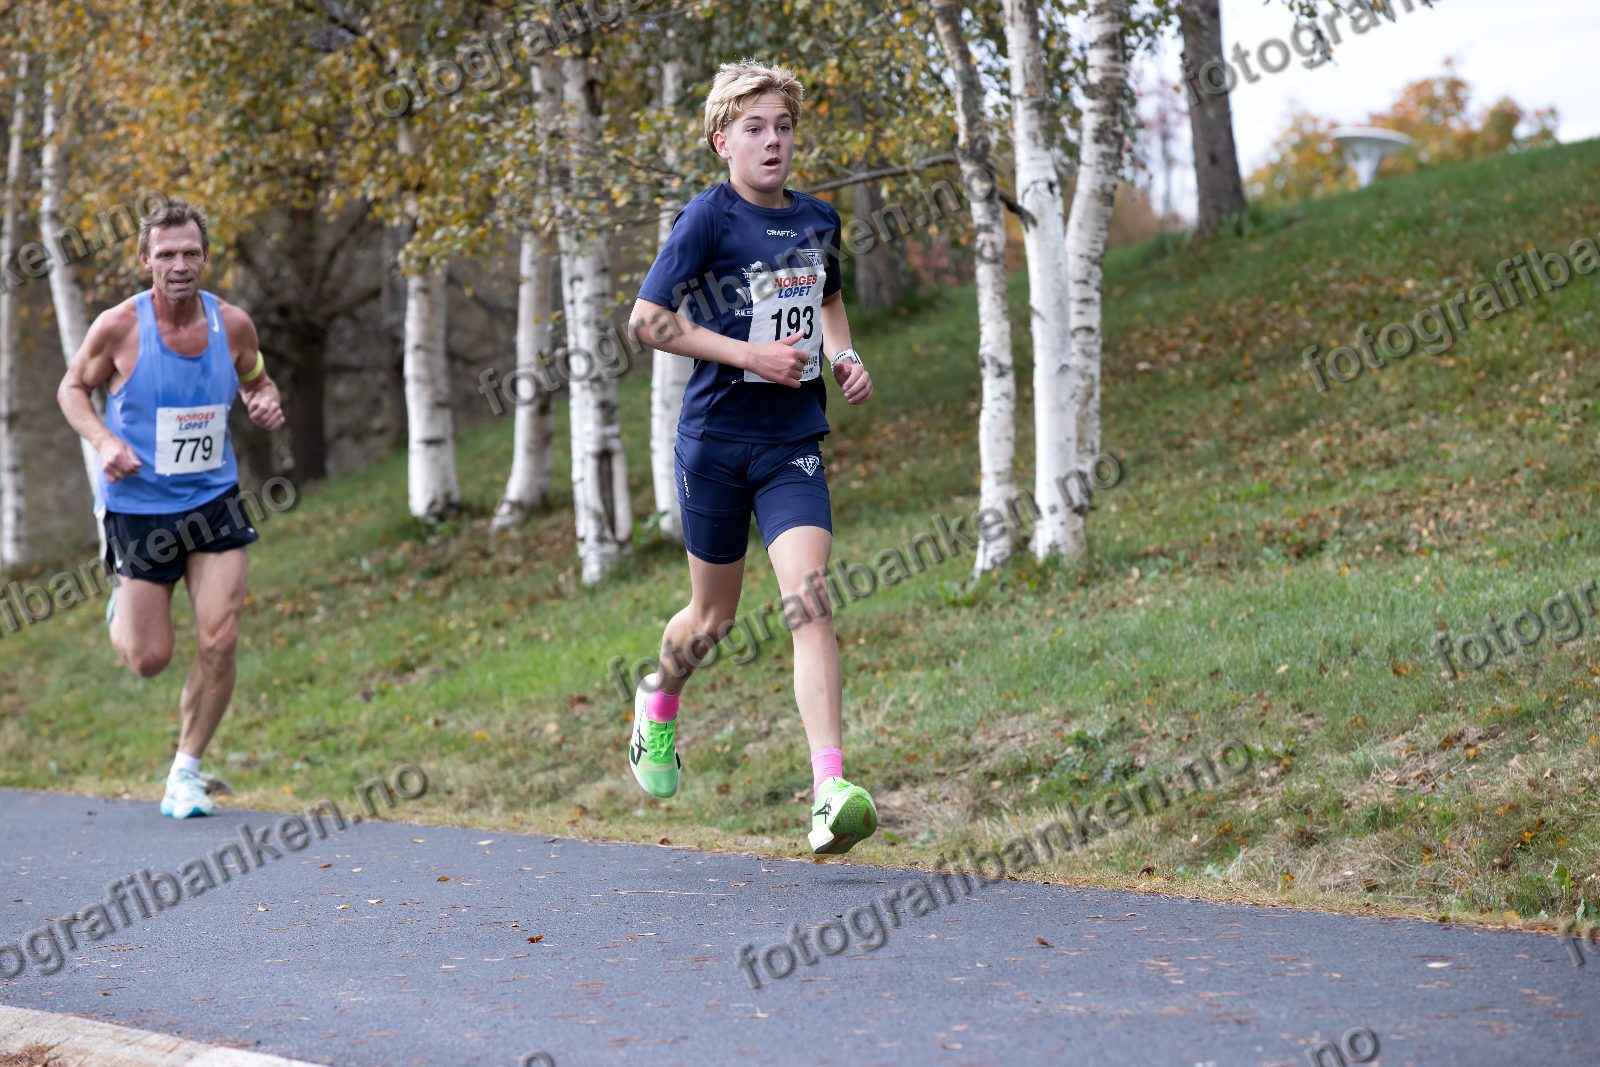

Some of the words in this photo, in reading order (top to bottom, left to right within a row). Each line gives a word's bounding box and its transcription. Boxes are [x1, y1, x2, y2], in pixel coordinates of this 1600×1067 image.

[766, 229, 790, 237] CRAFT
[773, 274, 817, 289] NORGES
[777, 286, 811, 299] LØPET
[771, 305, 814, 341] 193
[172, 435, 213, 463] 779
